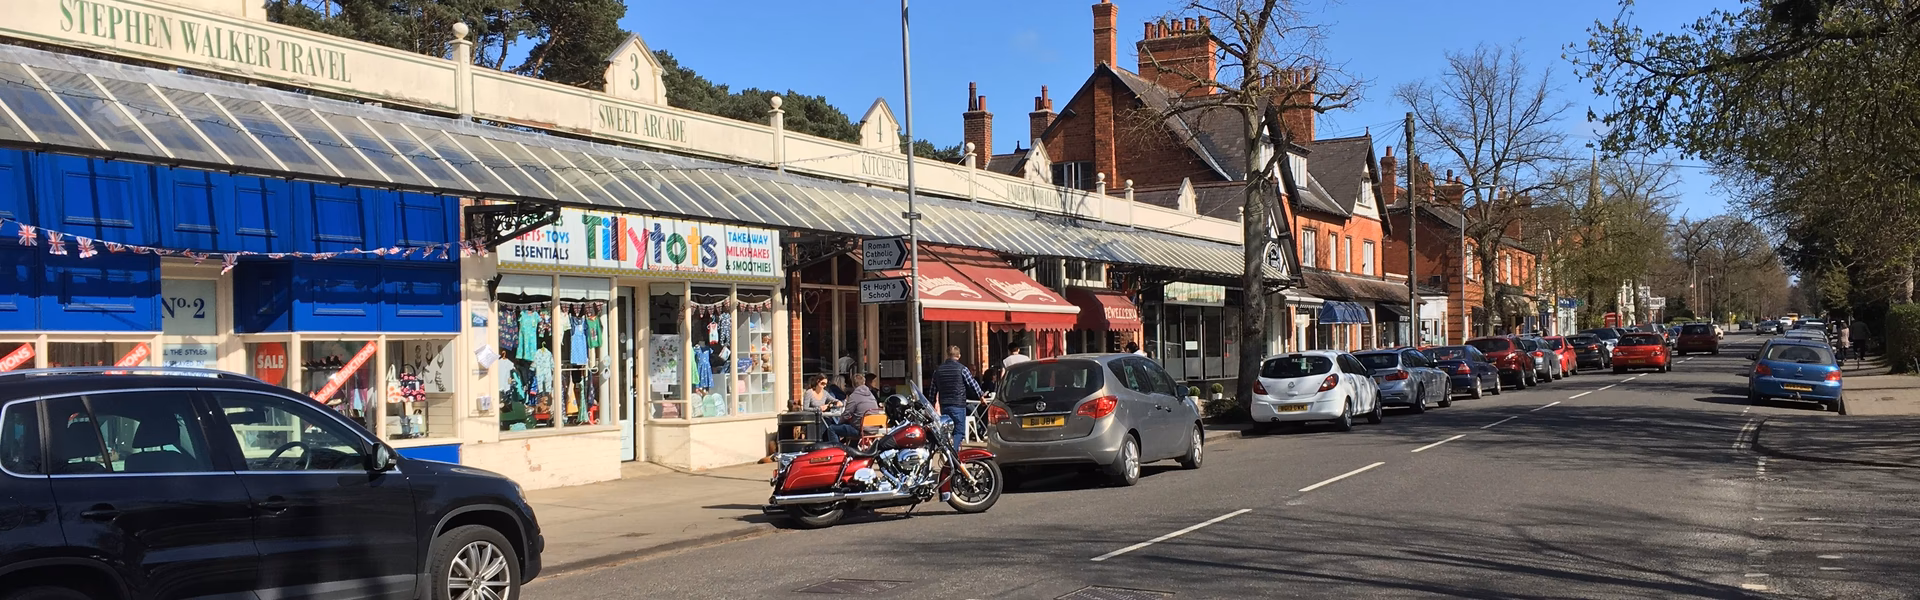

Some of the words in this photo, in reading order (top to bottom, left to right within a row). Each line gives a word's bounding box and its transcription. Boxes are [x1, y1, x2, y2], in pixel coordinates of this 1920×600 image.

[60, 0, 172, 50] STEPHEN
[179, 19, 271, 69] WALKER
[276, 39, 352, 83] TRAVEL
[630, 52, 640, 91] 3
[598, 104, 639, 135] SWEET
[643, 112, 687, 144] ARCADE
[876, 113, 883, 143] 4
[545, 229, 570, 244] TOYS
[582, 213, 718, 270] Tillytots
[727, 231, 769, 245] TAKEAWAY
[514, 244, 569, 261] ESSENTIALS
[726, 245, 770, 260] MILKSHAKES
[867, 242, 890, 250] Roman
[865, 250, 893, 258] Catholic
[725, 260, 731, 271] &
[732, 260, 772, 273] SMOOTHIES
[867, 258, 892, 266] Church
[873, 283, 896, 291] Hugh's
[868, 291, 891, 299] School
[193, 297, 205, 319] 2
[170, 348, 183, 356] THE
[184, 348, 208, 356] STYLES
[257, 354, 284, 369] SALE
